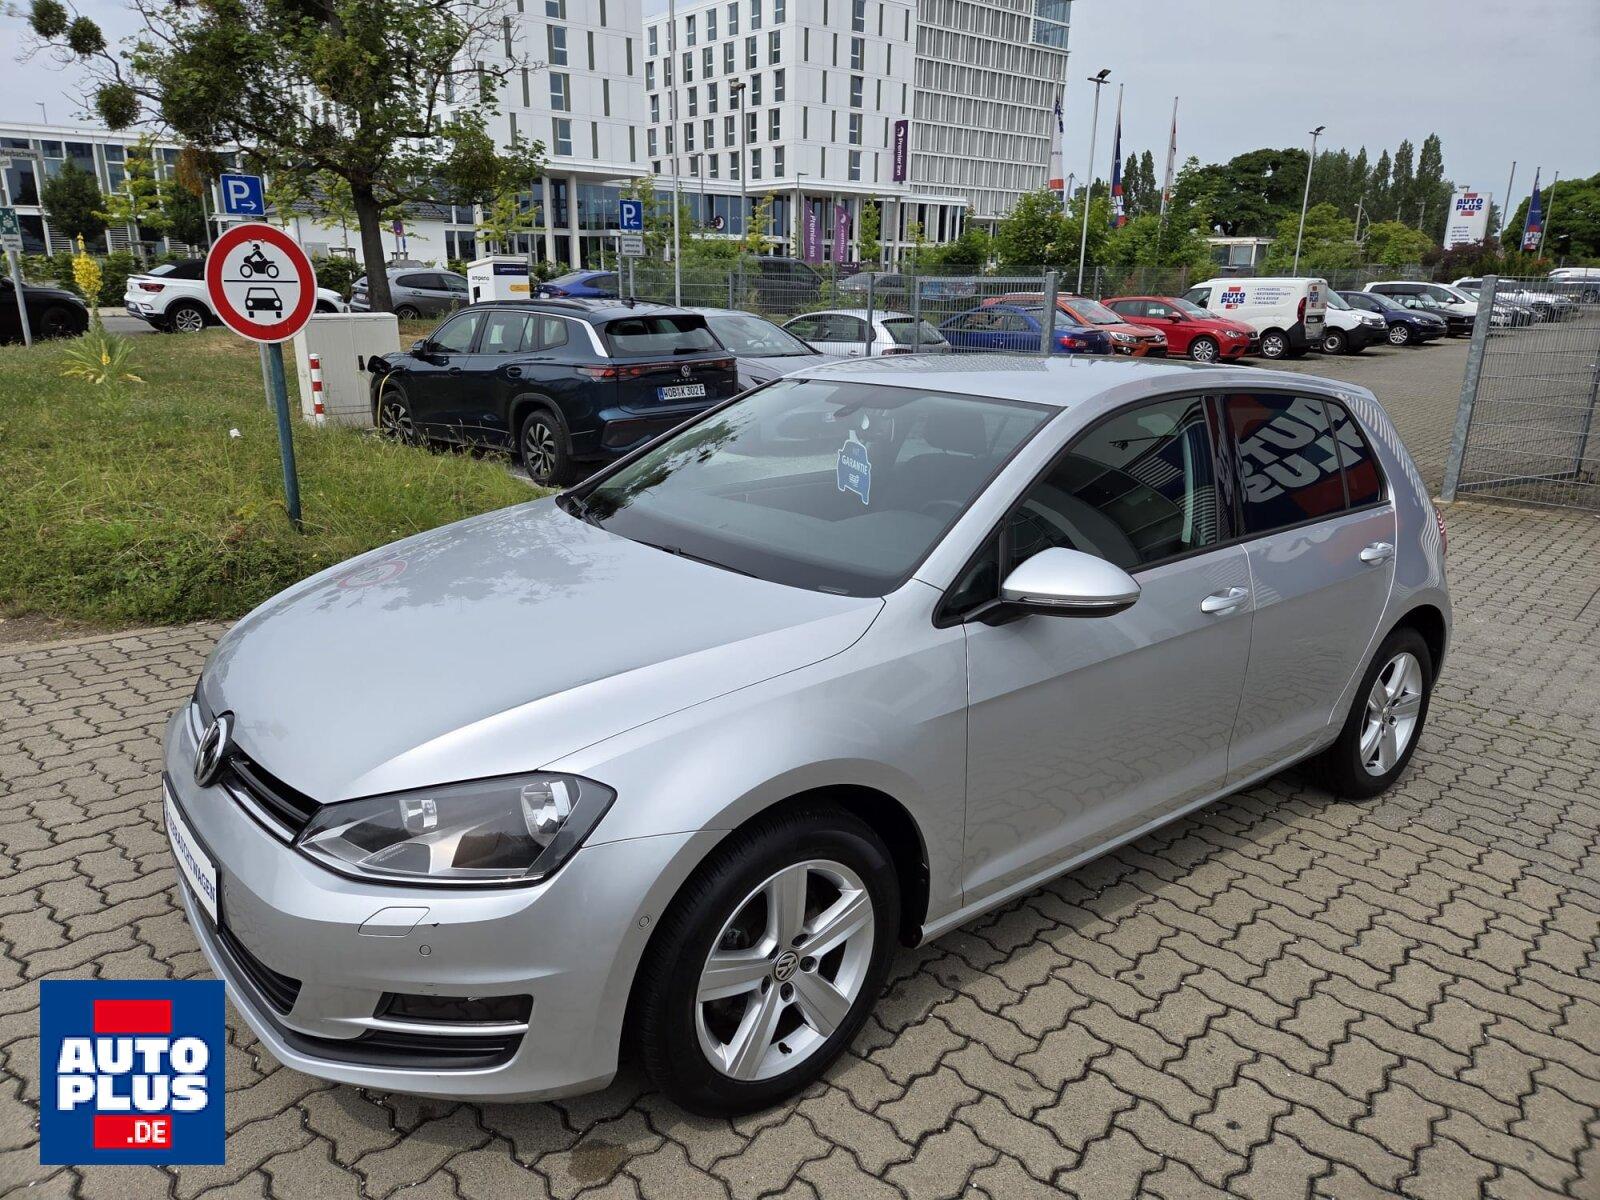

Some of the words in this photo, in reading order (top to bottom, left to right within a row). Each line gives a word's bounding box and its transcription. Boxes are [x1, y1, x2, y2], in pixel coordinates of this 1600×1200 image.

[228, 180, 250, 209] P
[623, 204, 636, 226] P
[842, 455, 868, 475] GARANTIE
